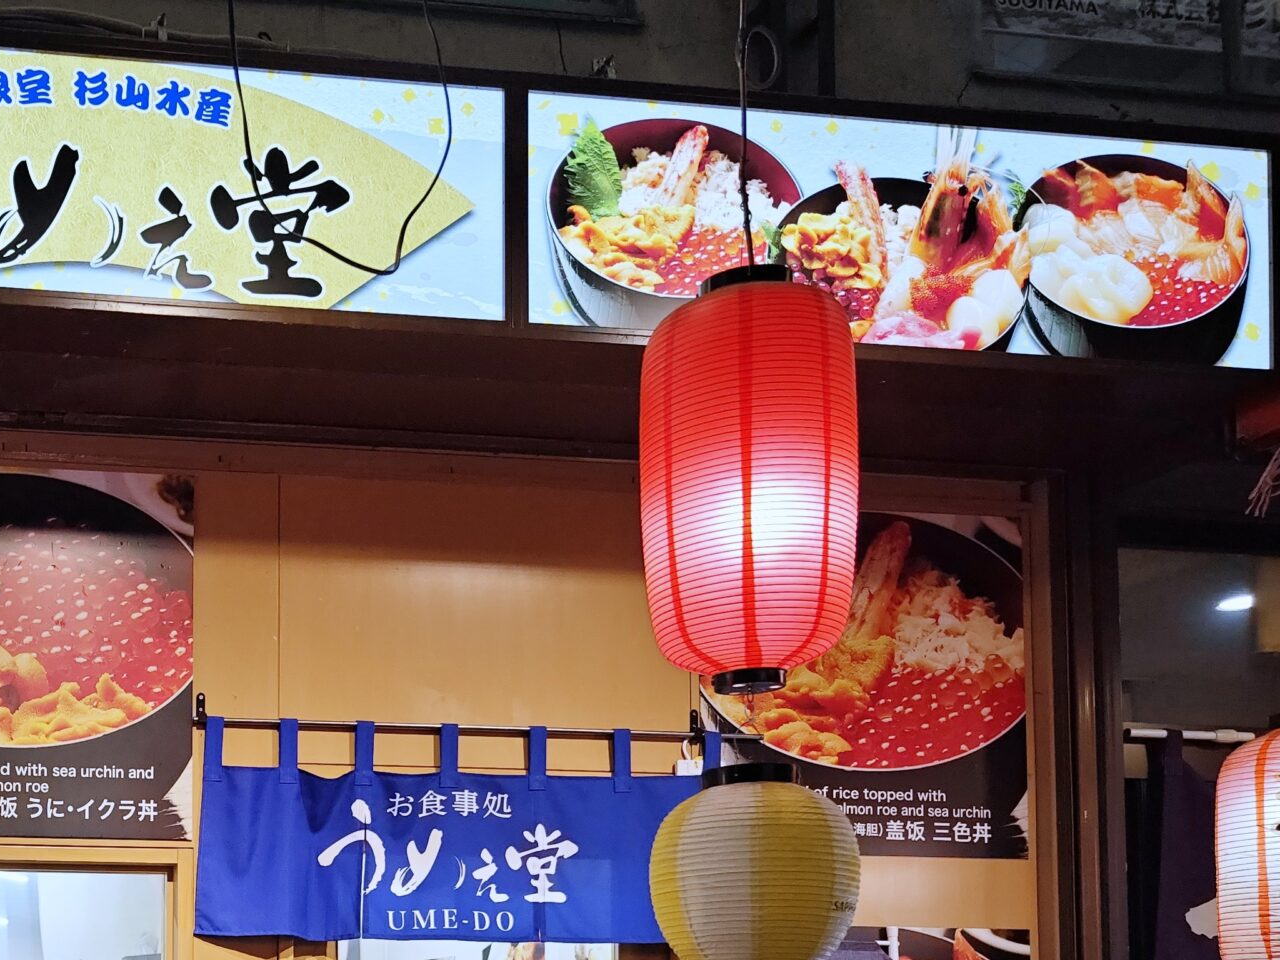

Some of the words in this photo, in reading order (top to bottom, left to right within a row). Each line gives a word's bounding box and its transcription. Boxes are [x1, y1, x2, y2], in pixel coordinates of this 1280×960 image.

[73, 68, 232, 128] 杉山水産
[15, 763, 48, 777] with
[52, 765, 77, 778] sea
[80, 765, 124, 779] urchin
[128, 765, 155, 780] and
[25, 780, 49, 793] roe
[832, 786, 860, 800] rice
[864, 788, 913, 803] topped
[917, 789, 947, 802] with
[26, 799, 158, 822] うに・イクラ丼
[386, 789, 513, 819] お食事処
[877, 805, 898, 816] roe
[901, 804, 924, 817] and
[927, 807, 949, 818] sea
[952, 806, 991, 819] urchin
[932, 821, 993, 844] 三色丼
[387, 907, 516, 932] UME-DO
